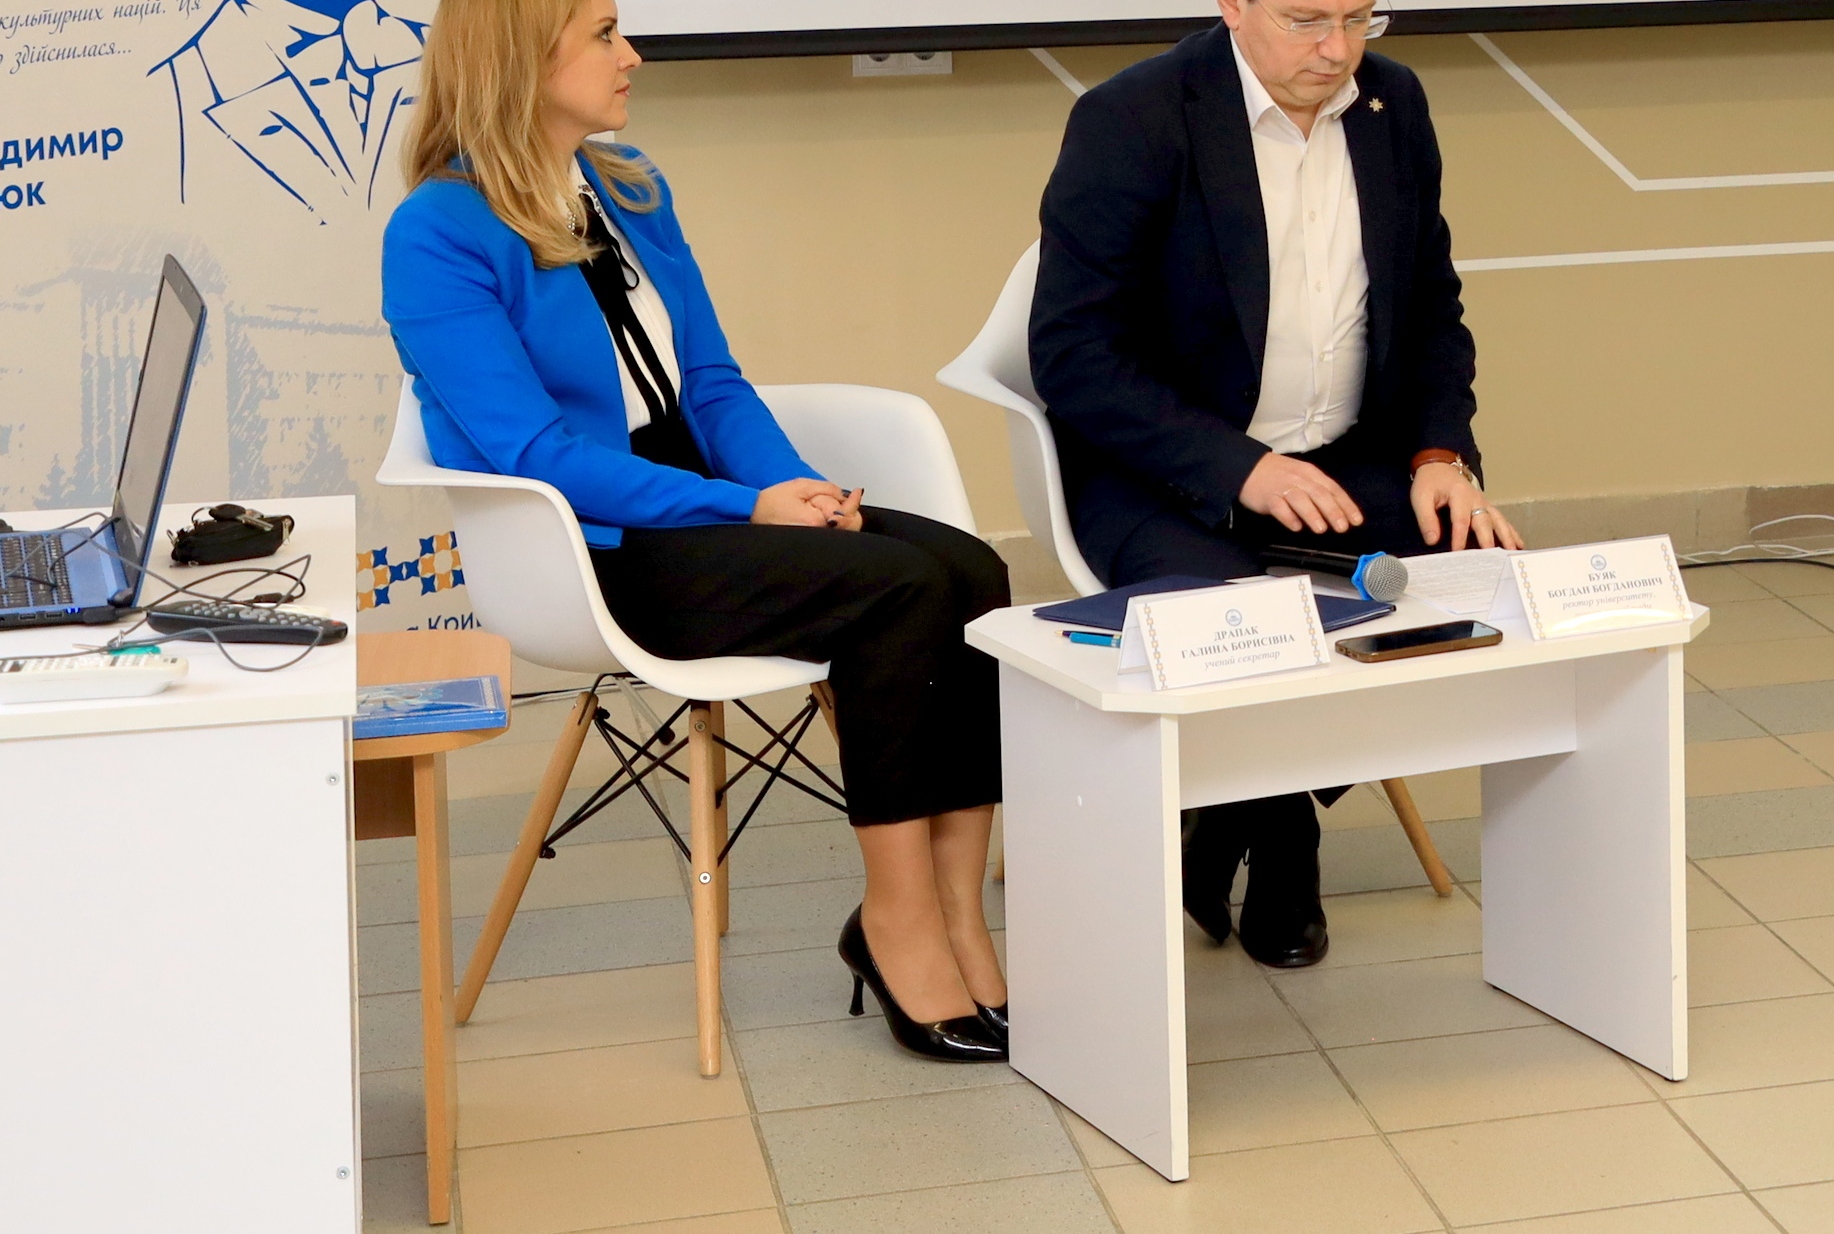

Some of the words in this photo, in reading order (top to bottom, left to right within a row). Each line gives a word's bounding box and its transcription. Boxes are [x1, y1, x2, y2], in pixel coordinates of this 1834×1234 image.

[10, 41, 132, 75] здійснилася...
[1588, 571, 1617, 582] БУЯК
[1547, 585, 1591, 598] БОГДАН
[1592, 577, 1663, 594] БОГДАНОВИЧ
[1562, 598, 1594, 610] ректор
[1214, 625, 1259, 642] ДРАПАК
[1181, 643, 1229, 659] ГАЛИНА
[1231, 634, 1295, 652] БОРИСІВНА
[1203, 655, 1235, 671] учений
[1237, 650, 1281, 665] секретар
